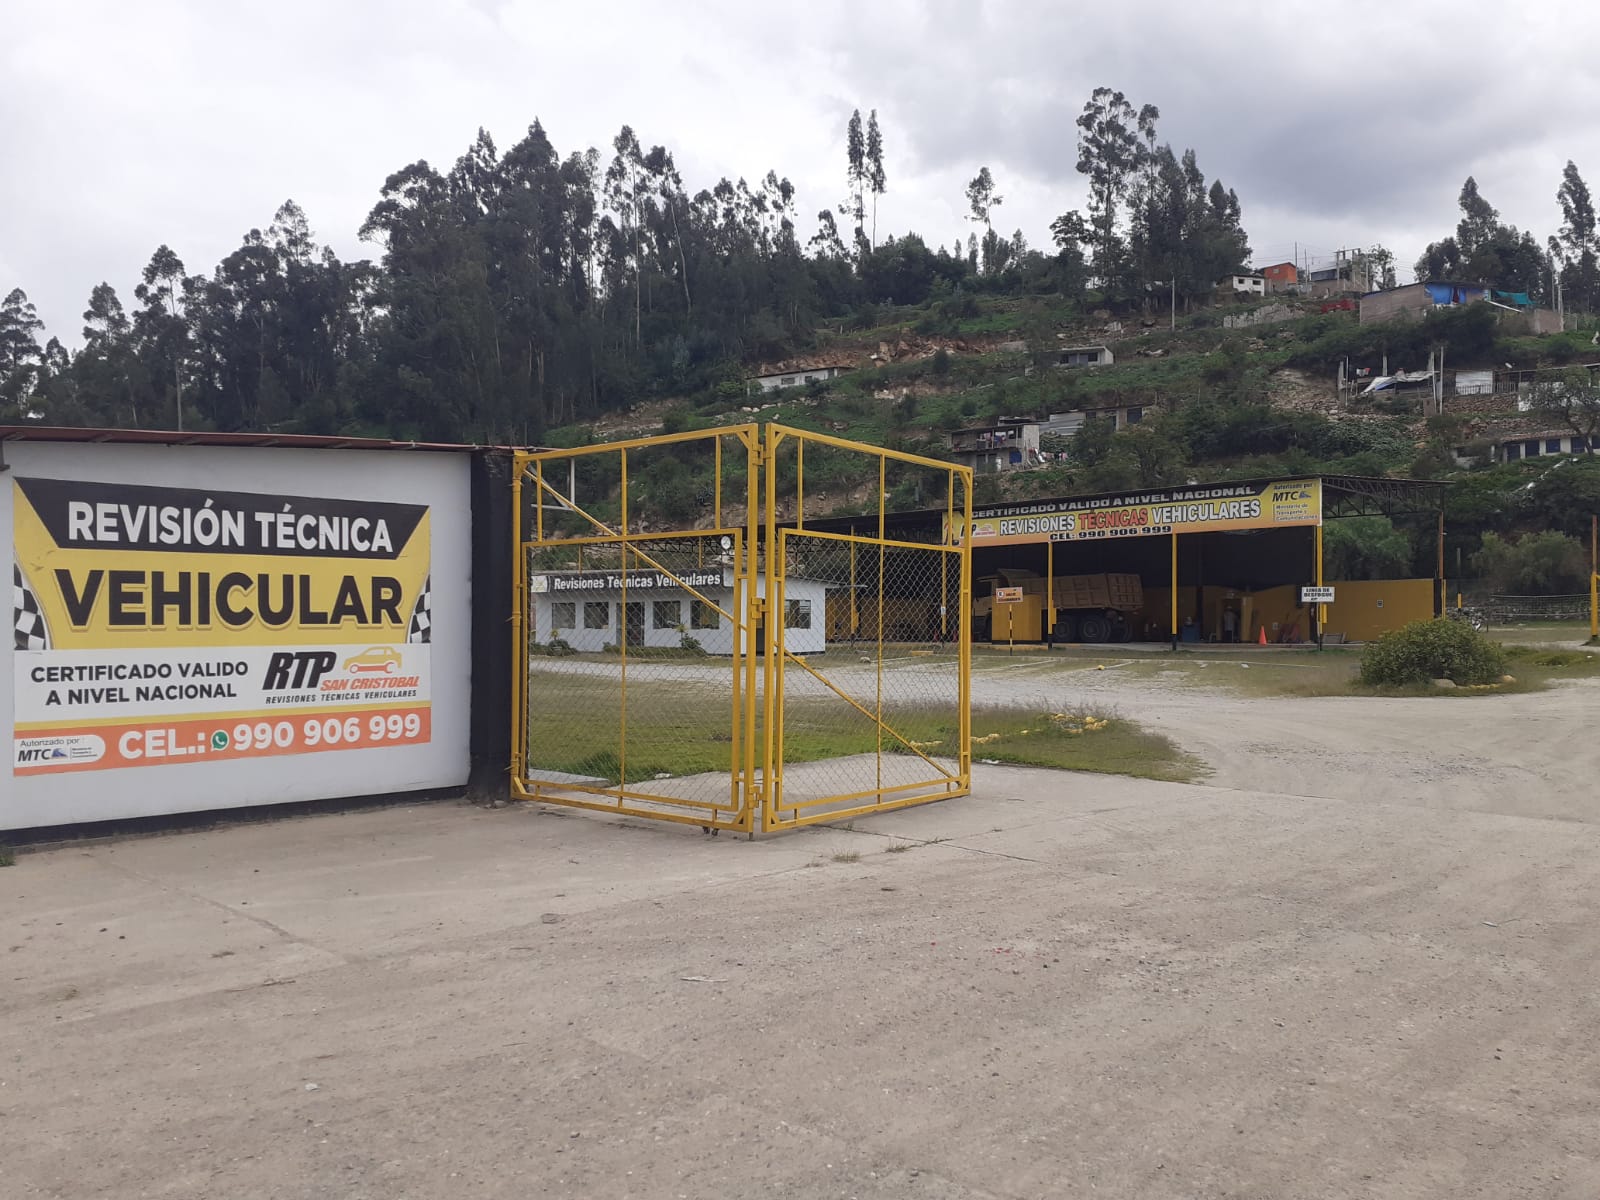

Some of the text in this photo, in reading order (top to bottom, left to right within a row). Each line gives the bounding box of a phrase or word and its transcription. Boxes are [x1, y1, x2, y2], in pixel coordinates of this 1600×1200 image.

[971, 486, 1256, 518] CERTIFICADO VALIDO A NIVEL NACIONAL
[1272, 491, 1299, 502] MTC
[68, 497, 394, 553] REVISIÓN TÉCNICA
[999, 515, 1076, 536] REVISIONES
[1152, 499, 1262, 525] VEHICULARES
[1049, 525, 1172, 542] CEL: 990 906 999
[553, 576, 605, 591] Revisiones
[53, 568, 404, 627] VEHICULAR
[30, 661, 249, 683] CERTIFICADO VALIDO
[262, 651, 337, 691] RTP
[45, 683, 237, 706] A NIVEL NACIONAL
[320, 676, 420, 692] SAN CRISTOBAL
[265, 694, 317, 705] REVISIONES
[364, 689, 417, 700] VEHICULARES
[20, 739, 64, 747] Autorizado
[118, 728, 206, 760] CEL.:
[233, 721, 295, 751] 990
[303, 718, 361, 746] 906
[368, 712, 421, 741] 999
[18, 748, 51, 762] MTC
